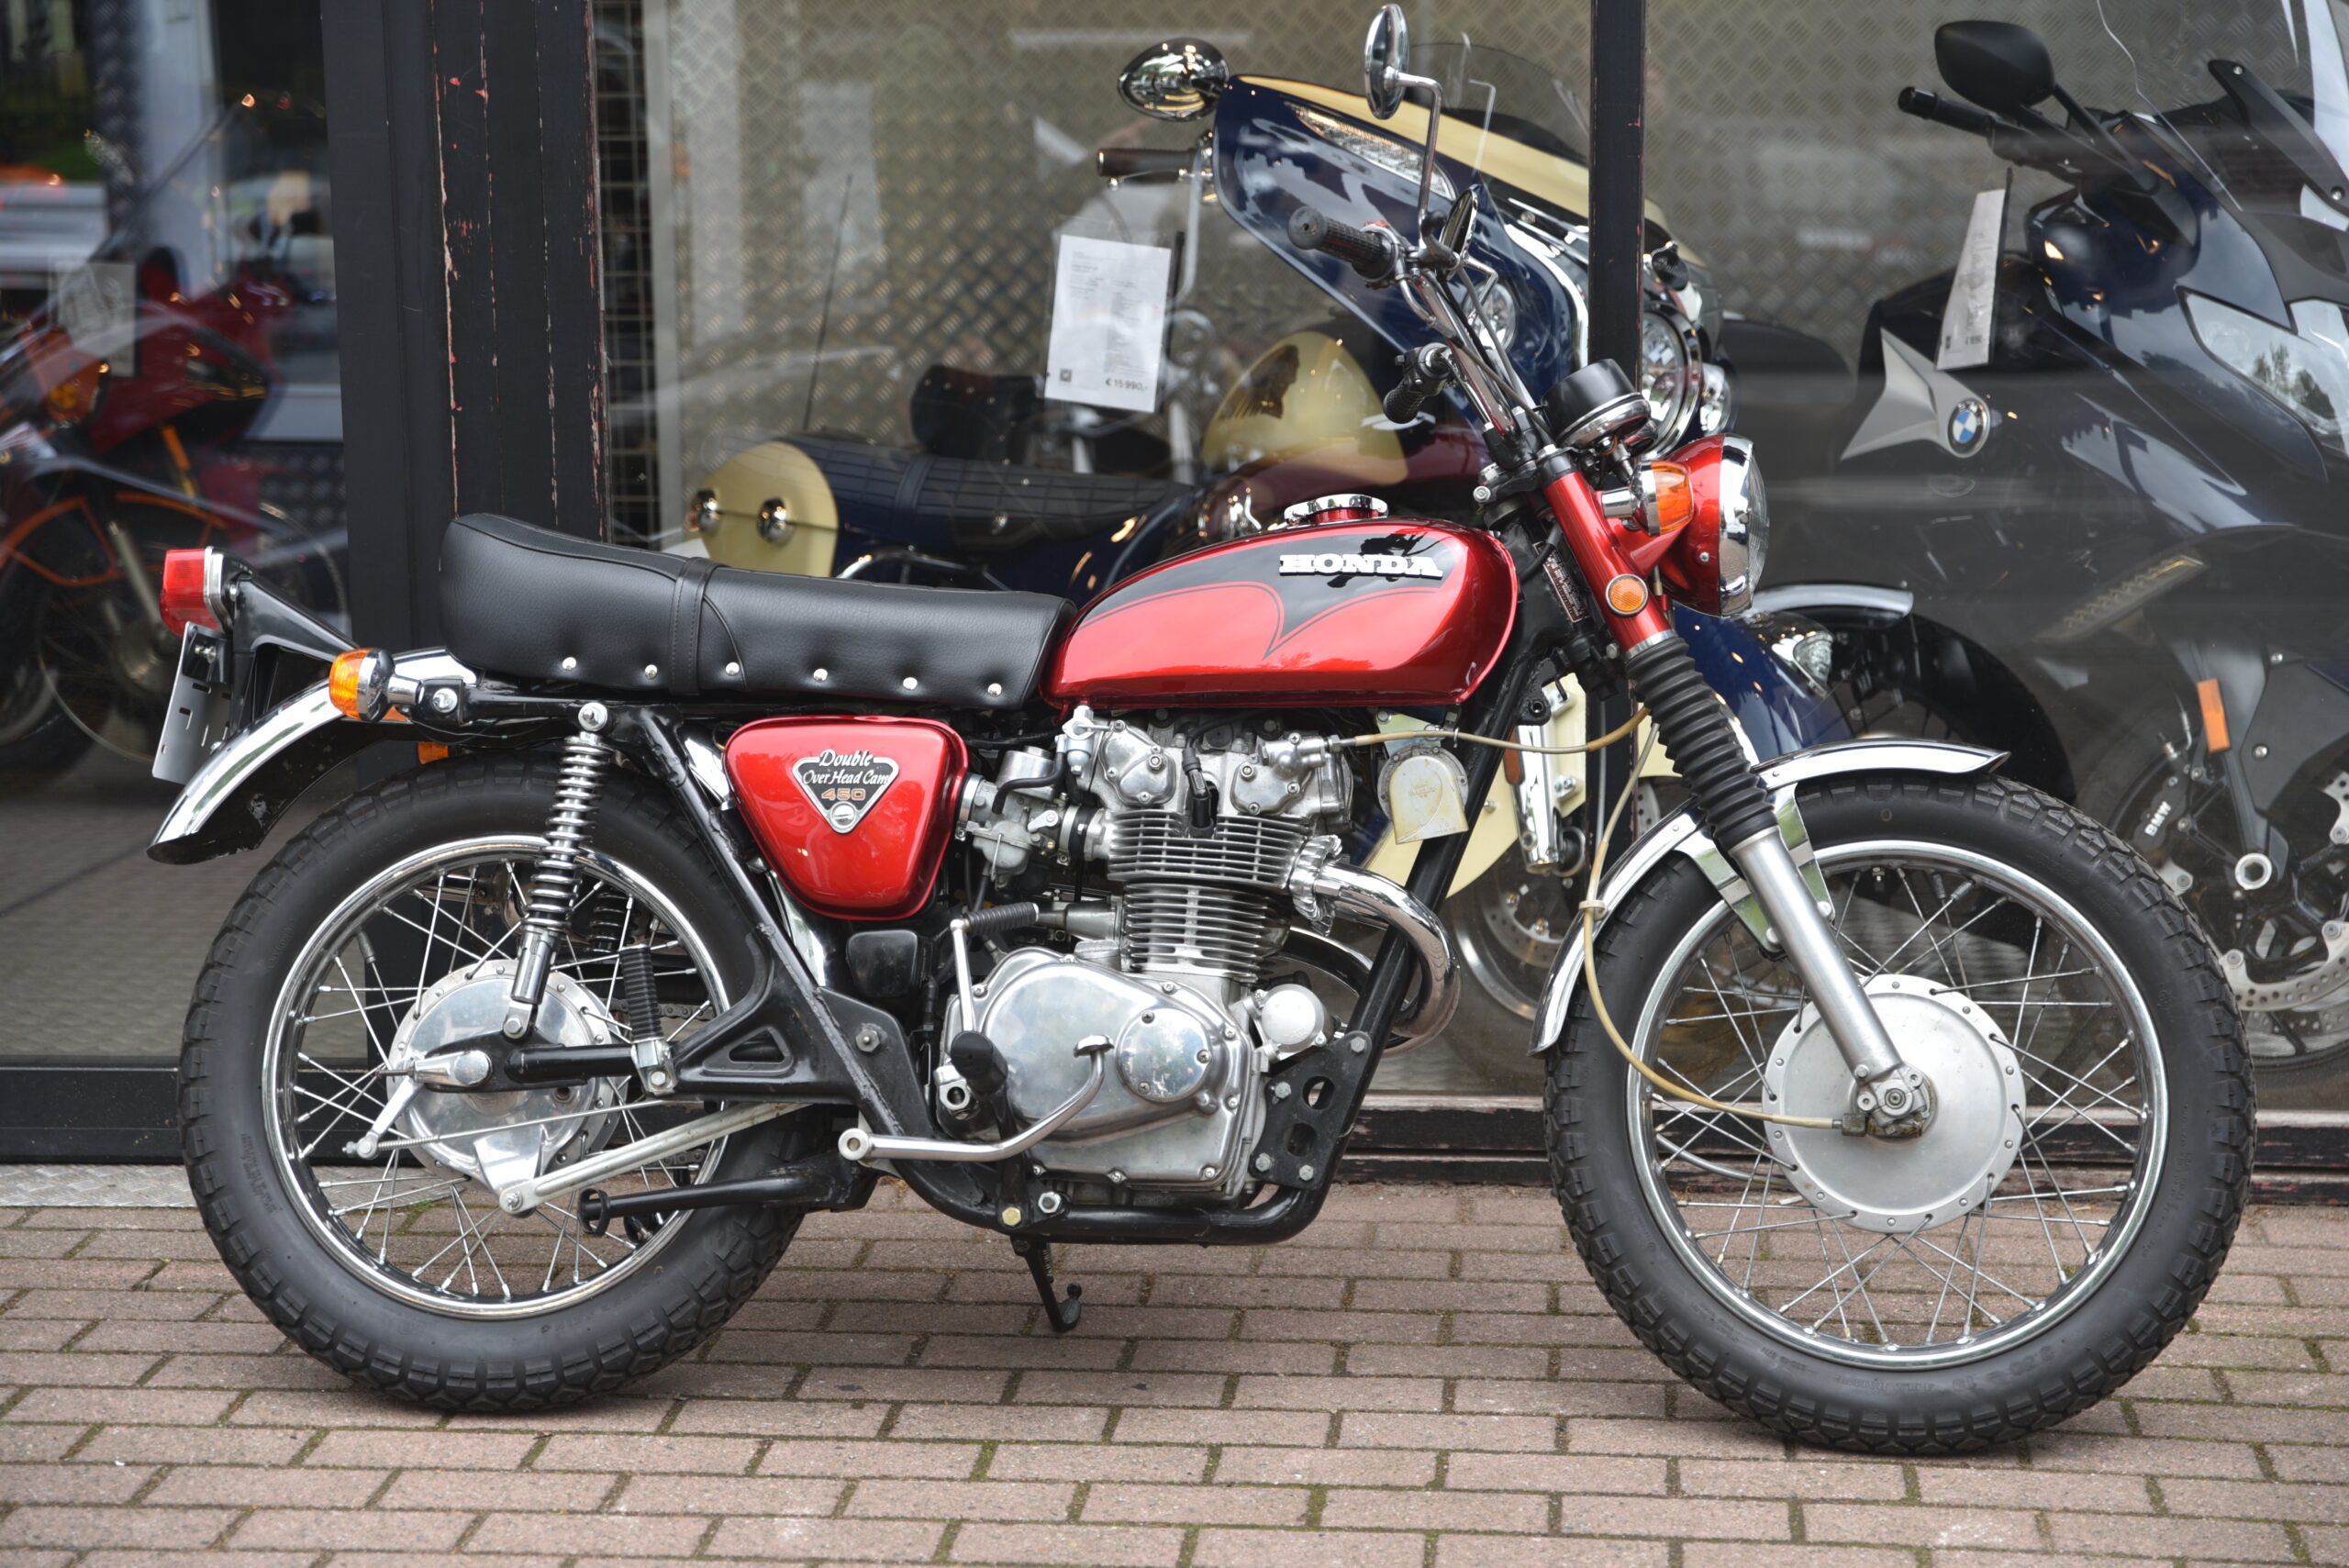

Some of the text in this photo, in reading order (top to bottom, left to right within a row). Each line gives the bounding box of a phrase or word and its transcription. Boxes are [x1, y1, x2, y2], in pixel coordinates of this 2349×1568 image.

[1279, 553, 1443, 579] HONDA
[818, 749, 874, 767] Double
[803, 769, 890, 785] Over Head Cam
[821, 788, 866, 801] 450
[2144, 801, 2171, 837] BMW
